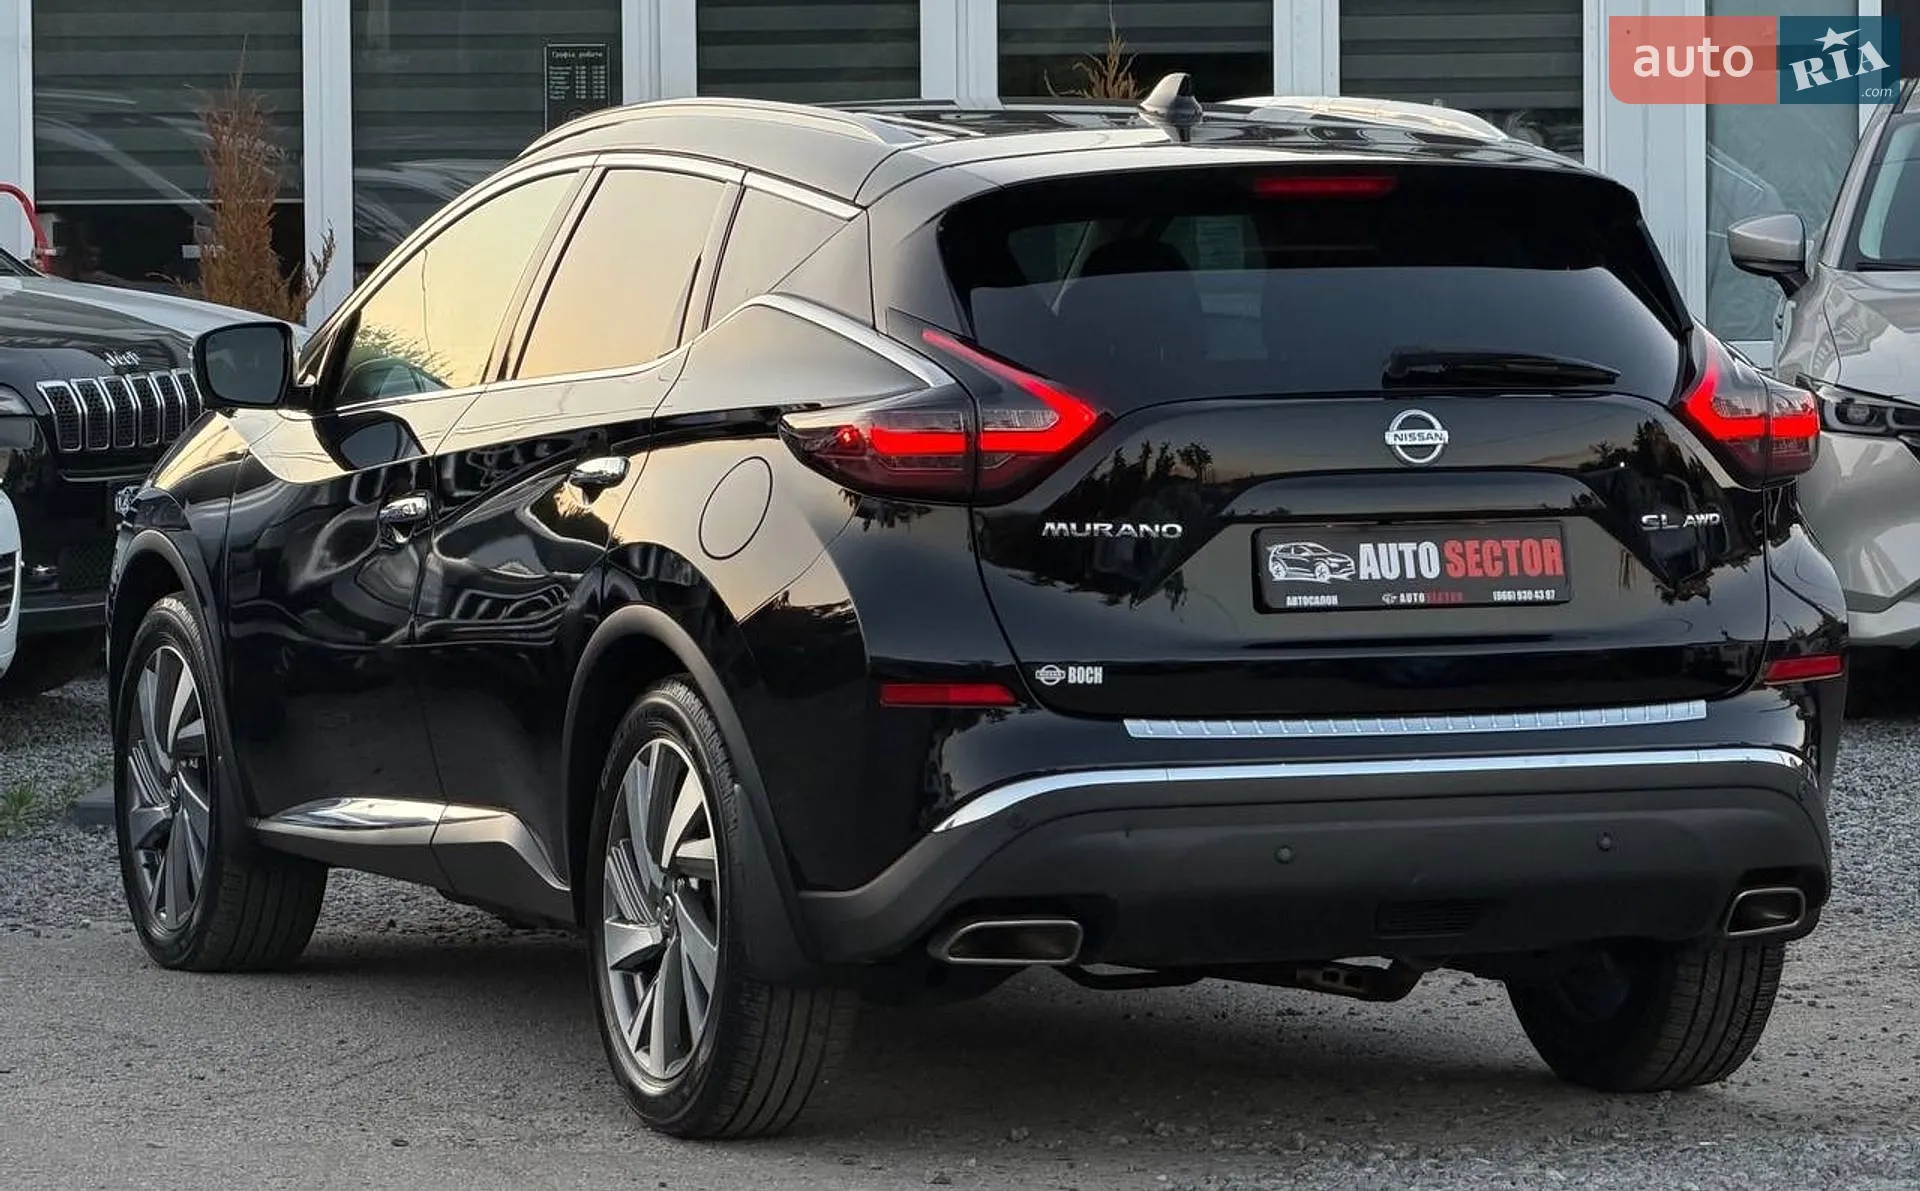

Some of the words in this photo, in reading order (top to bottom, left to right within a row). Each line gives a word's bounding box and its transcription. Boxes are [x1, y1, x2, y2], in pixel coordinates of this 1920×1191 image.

[1392, 431, 1444, 442] NISSAN
[1041, 521, 1183, 539] MURANO
[1641, 514, 1679, 531] SL
[1682, 512, 1721, 528] AWD
[1358, 541, 1441, 581] AUTO
[1443, 538, 1565, 578] SECTOR
[1067, 665, 1104, 685] BOCH
